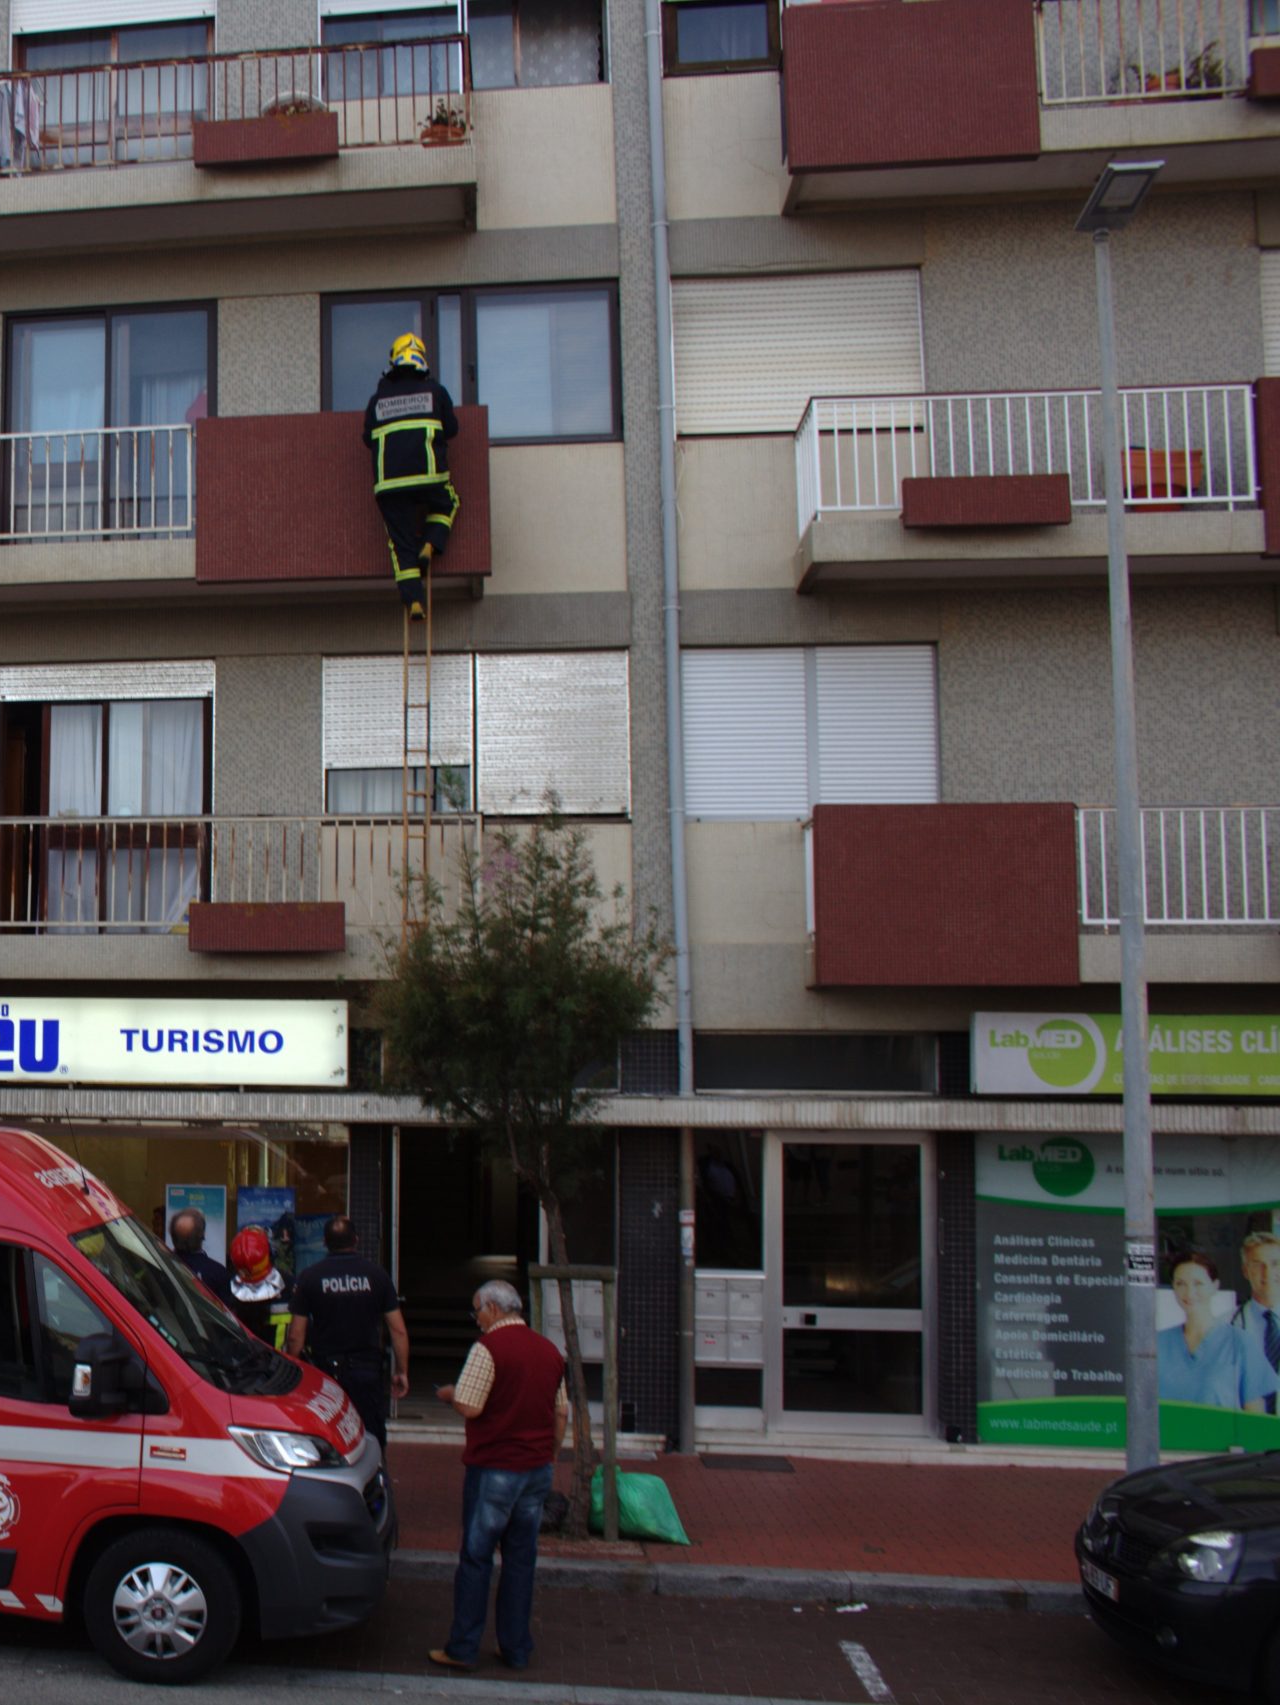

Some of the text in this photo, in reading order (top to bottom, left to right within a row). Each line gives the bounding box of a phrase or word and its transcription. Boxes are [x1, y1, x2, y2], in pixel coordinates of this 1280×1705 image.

[120, 1028, 284, 1054] TURISMO
[1240, 1024, 1280, 1054] CLÍ
[994, 1234, 1044, 1247] Análises
[994, 1254, 1102, 1267] Medicina Dentária
[322, 1274, 371, 1293] POLÍCIA
[994, 1273, 1052, 1285] Consultas
[1056, 1274, 1070, 1286] de
[1074, 1274, 1125, 1288] Especial
[994, 1291, 1062, 1305] Cardiologia
[994, 1311, 1069, 1324] Enfermagem
[994, 1330, 1105, 1343] Apoio Domiciliário
[995, 1348, 1043, 1361] Estética
[995, 1368, 1123, 1382] Medicina do Trabalho
